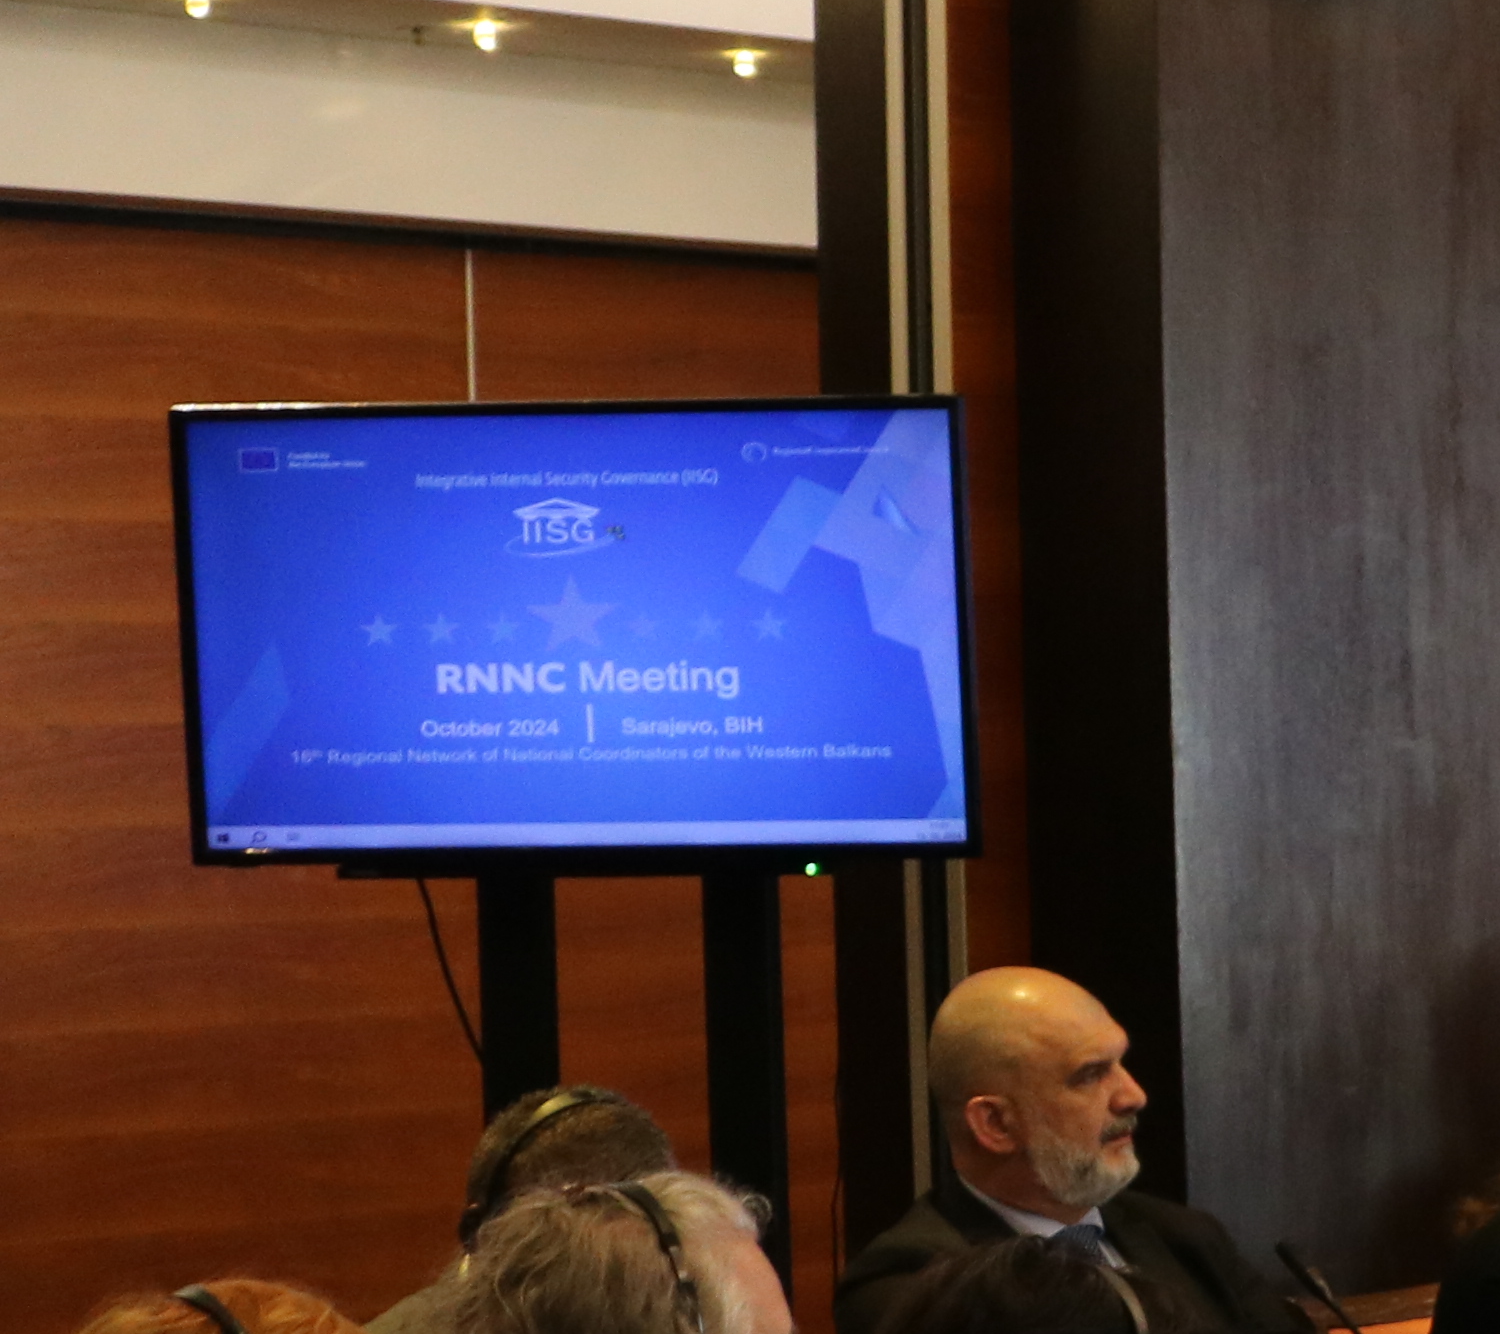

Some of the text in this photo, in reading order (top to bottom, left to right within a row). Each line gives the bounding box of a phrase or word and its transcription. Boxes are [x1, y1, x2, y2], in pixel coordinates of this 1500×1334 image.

[523, 518, 595, 544] IISG
[435, 660, 740, 699] RNNC Meeting
[420, 718, 560, 737] October 2024
[621, 716, 763, 738] Sarajevo, BIH
[327, 748, 402, 767] Regional
[407, 748, 478, 762] Network
[482, 747, 498, 761] of
[503, 747, 573, 761] National
[579, 746, 687, 761] Coordinators
[693, 745, 710, 760] of
[714, 745, 741, 759] the
[748, 744, 818, 759] Western
[823, 743, 892, 758] Balkans
